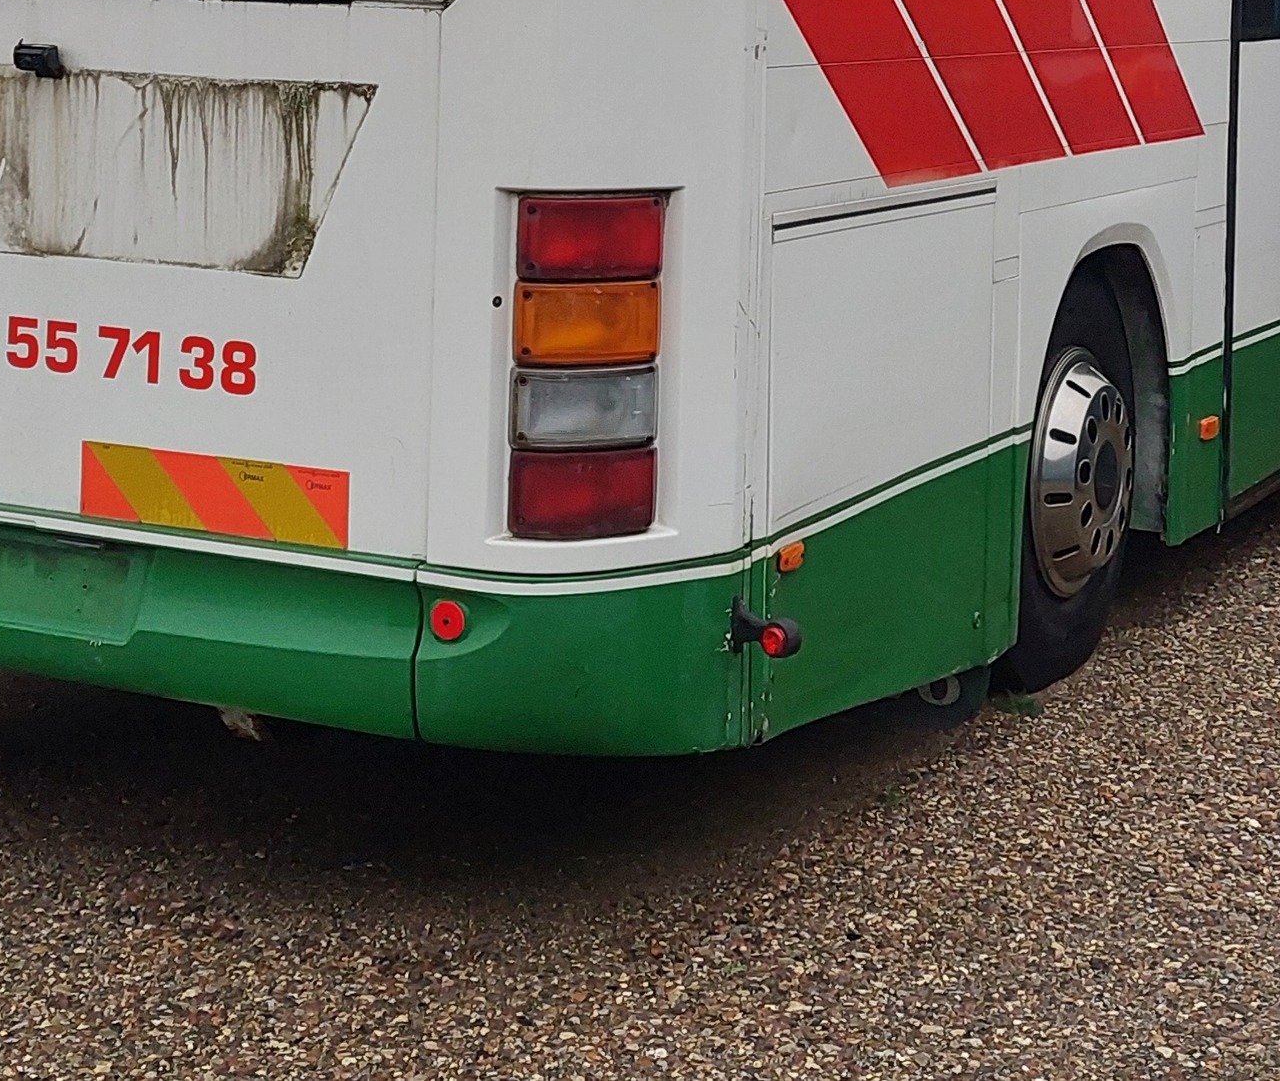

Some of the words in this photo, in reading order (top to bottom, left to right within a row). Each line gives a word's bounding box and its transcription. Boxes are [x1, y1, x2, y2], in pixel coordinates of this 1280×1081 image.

[6, 316, 79, 374] 55
[98, 325, 161, 385] 71
[178, 335, 257, 396] 38
